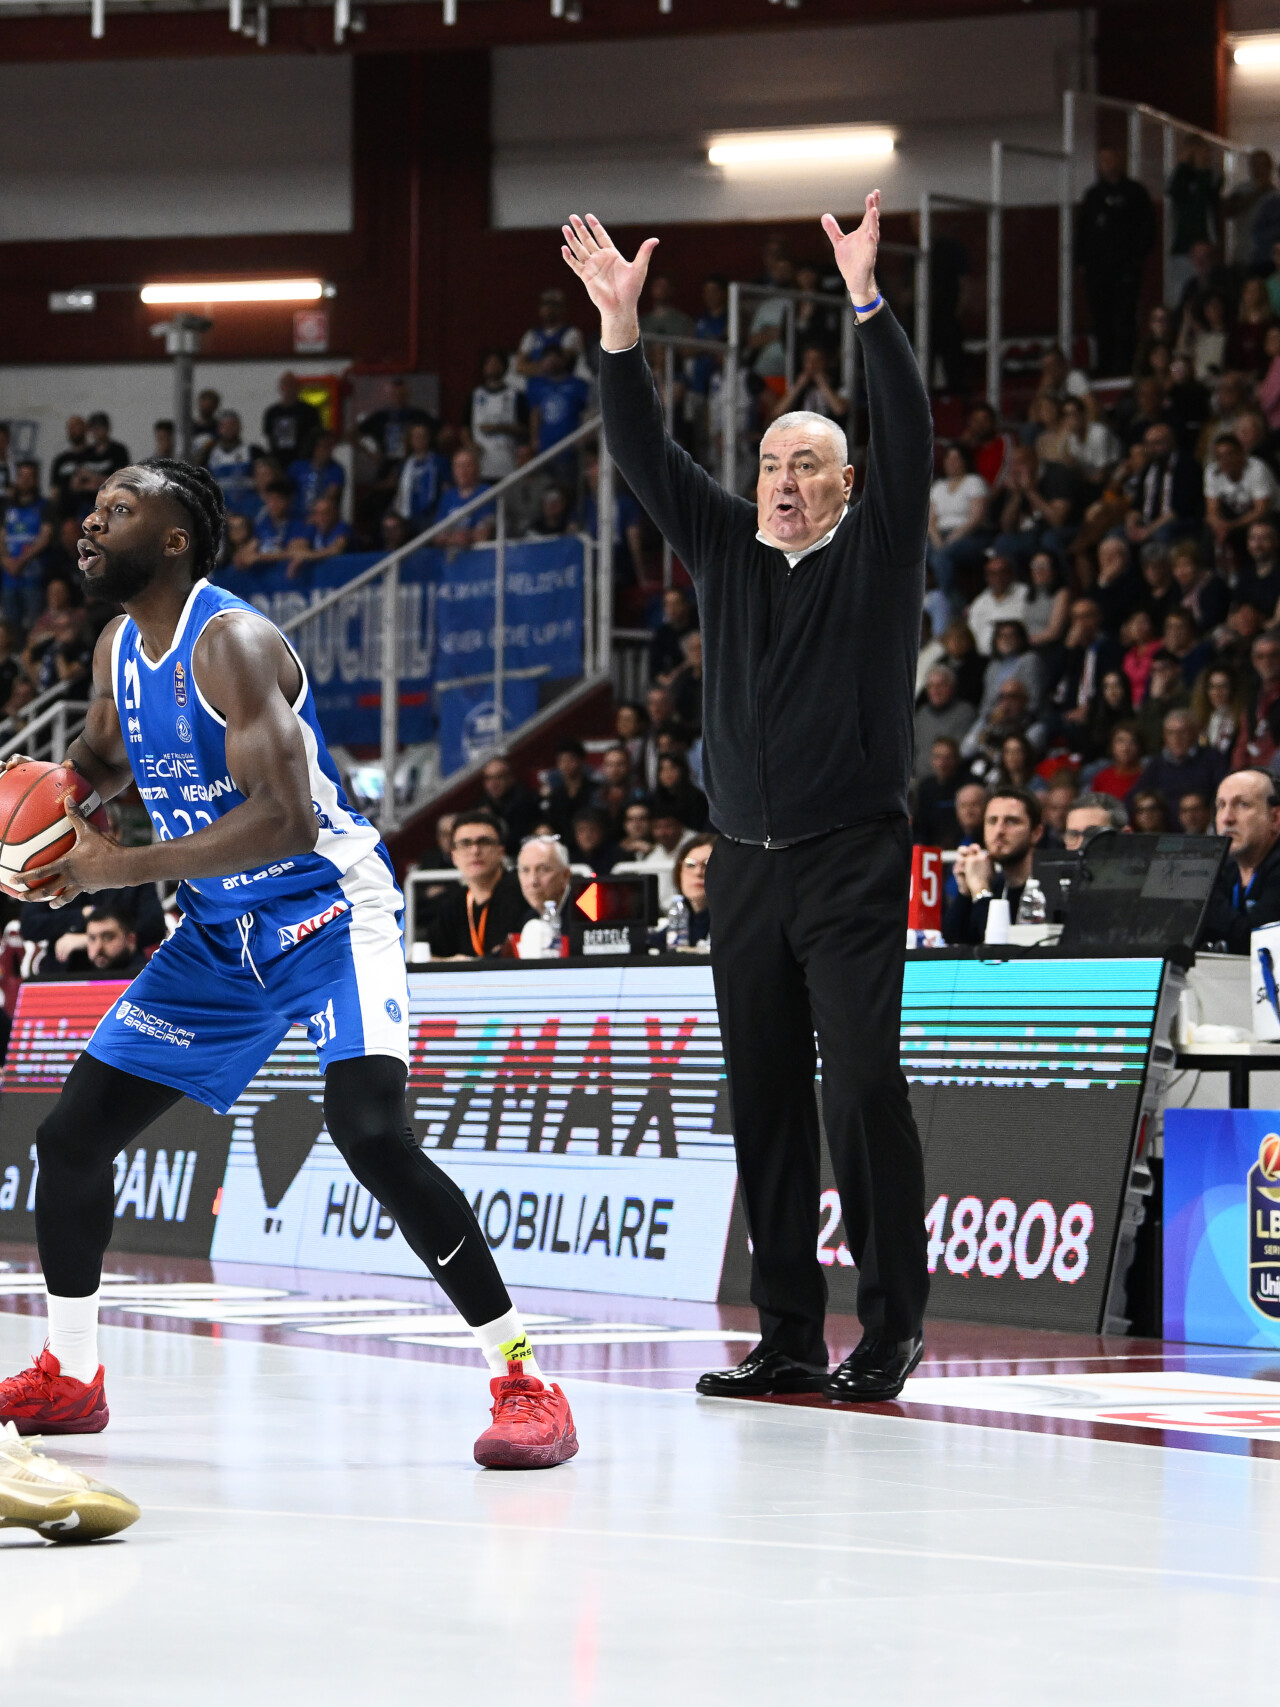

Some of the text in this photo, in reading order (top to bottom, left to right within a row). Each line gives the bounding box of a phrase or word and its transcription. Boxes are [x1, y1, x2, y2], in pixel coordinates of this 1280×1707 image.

[123, 1016, 191, 1049] BRESCIANA
[129, 1005, 196, 1040] ZINCATURA
[499, 1378, 533, 1392] RARE
